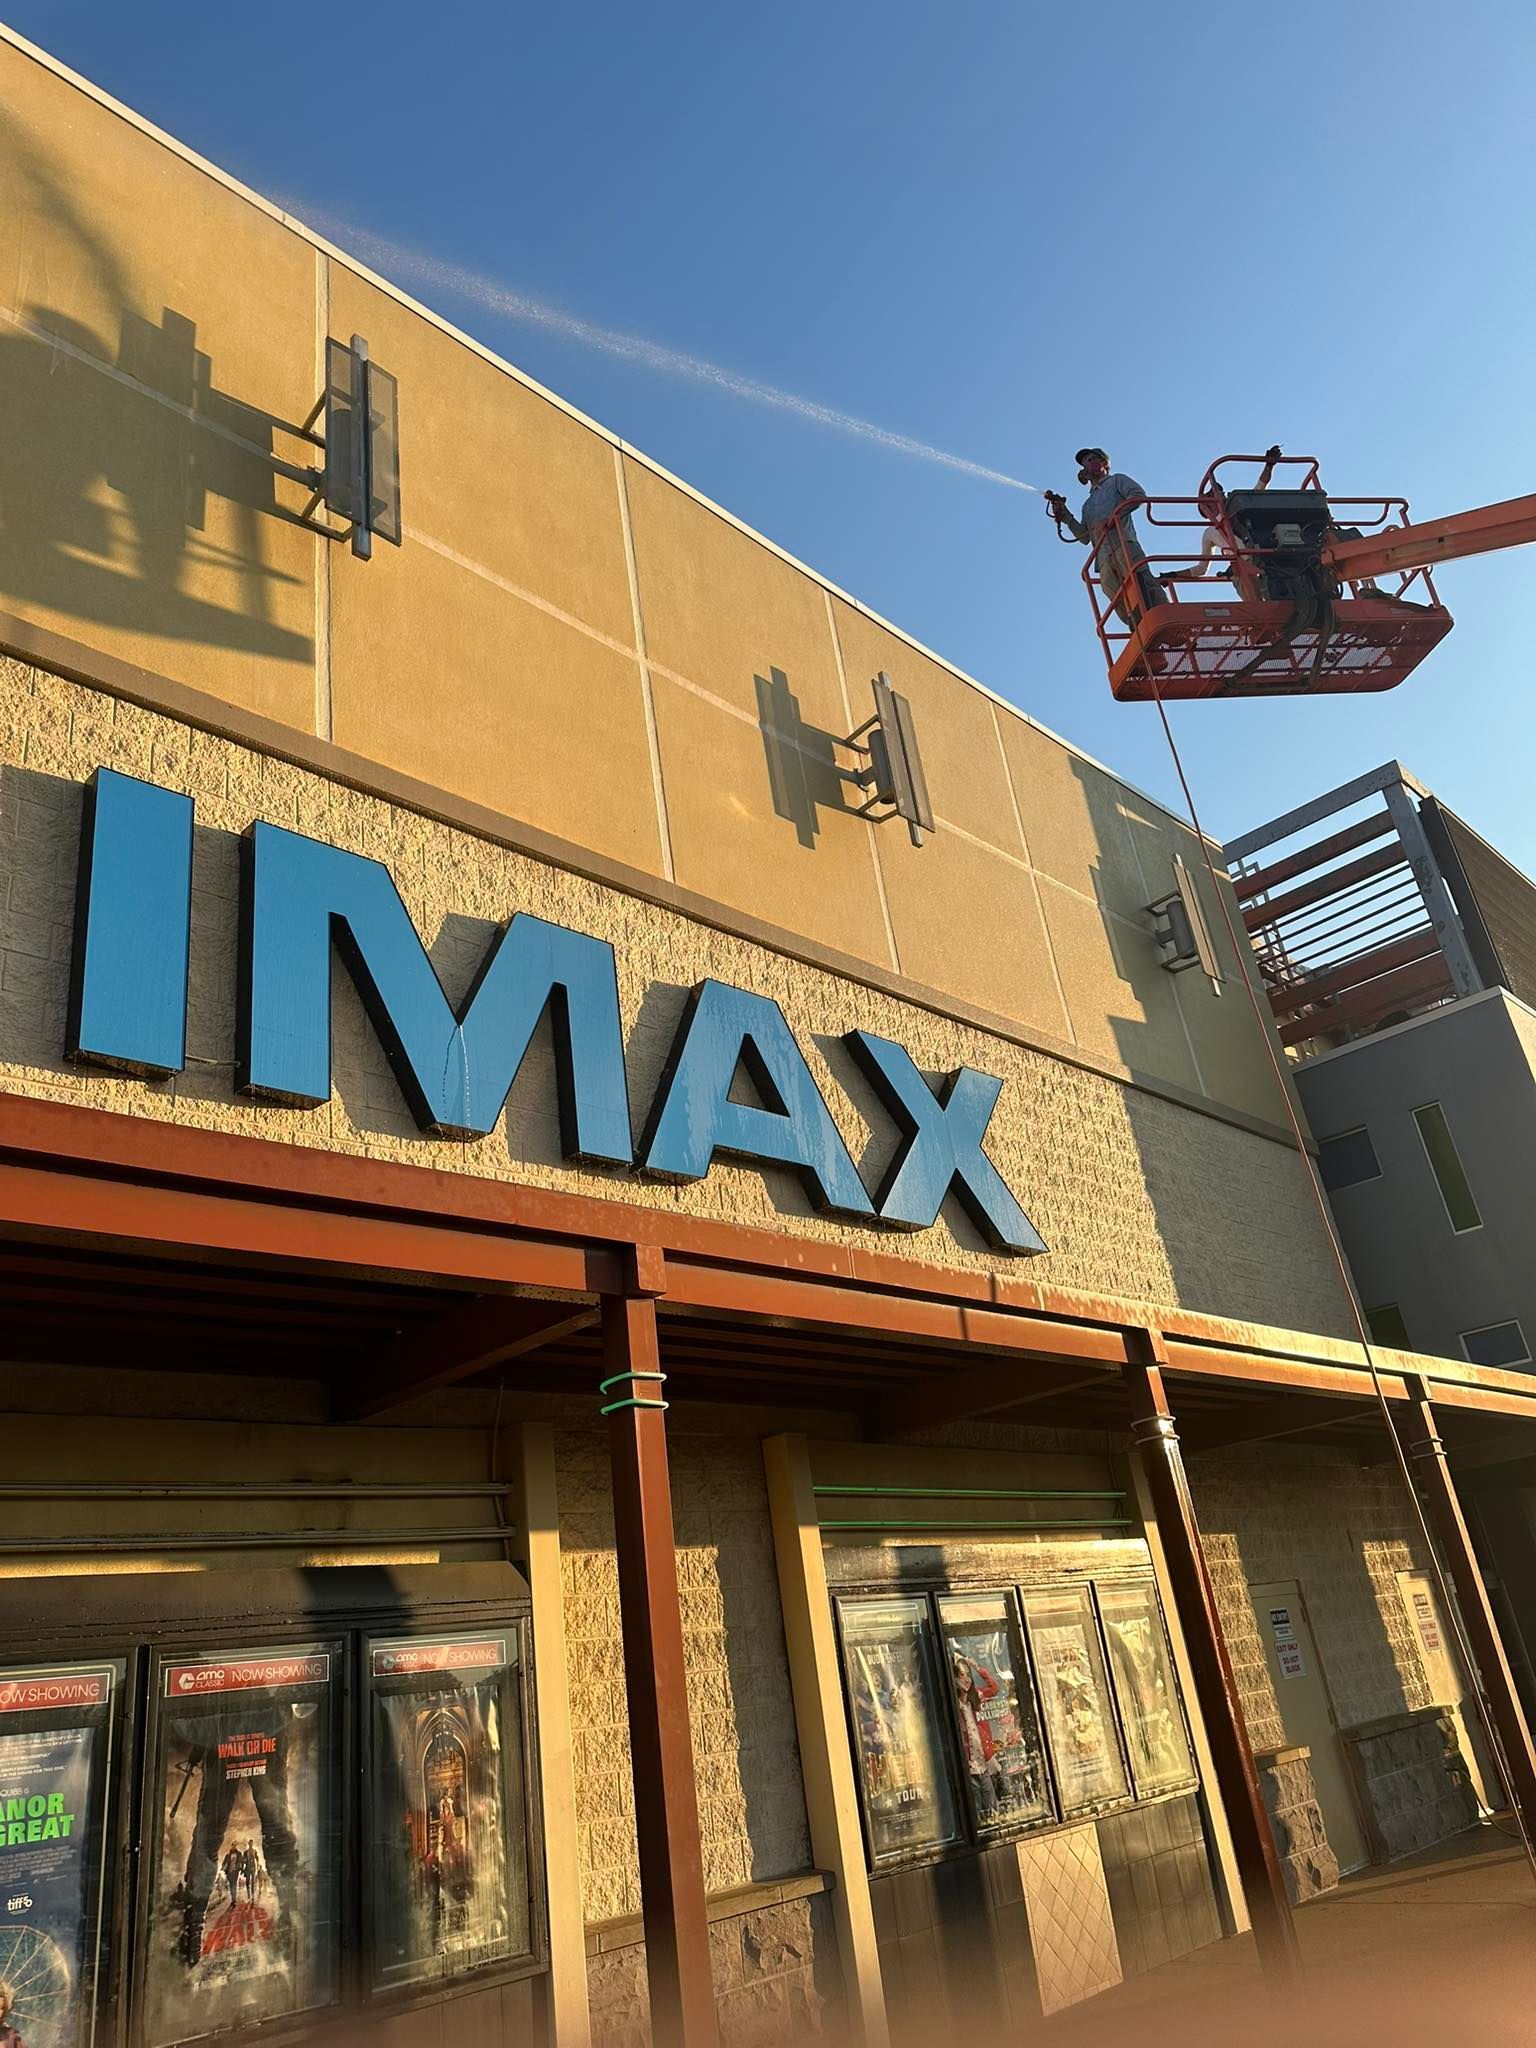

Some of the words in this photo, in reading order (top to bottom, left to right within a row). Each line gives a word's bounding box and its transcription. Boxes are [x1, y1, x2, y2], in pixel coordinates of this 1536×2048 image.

[66, 766, 1049, 1256] IMAX
[423, 1652, 449, 1665] NO
[449, 1648, 497, 1663] SHOWING
[196, 1669, 225, 1681] amc
[231, 1668, 265, 1682] NOW
[265, 1663, 322, 1679] SHOWING
[195, 1678, 225, 1689] CLASSIC
[28, 1683, 100, 1702] SHOWING
[217, 1741, 245, 1759] WALK
[246, 1740, 260, 1756] OR
[261, 1737, 277, 1754] DIE
[225, 1767, 253, 1780] STEPHEN
[252, 1765, 267, 1777] KING
[895, 1787, 924, 1804] TOUR
